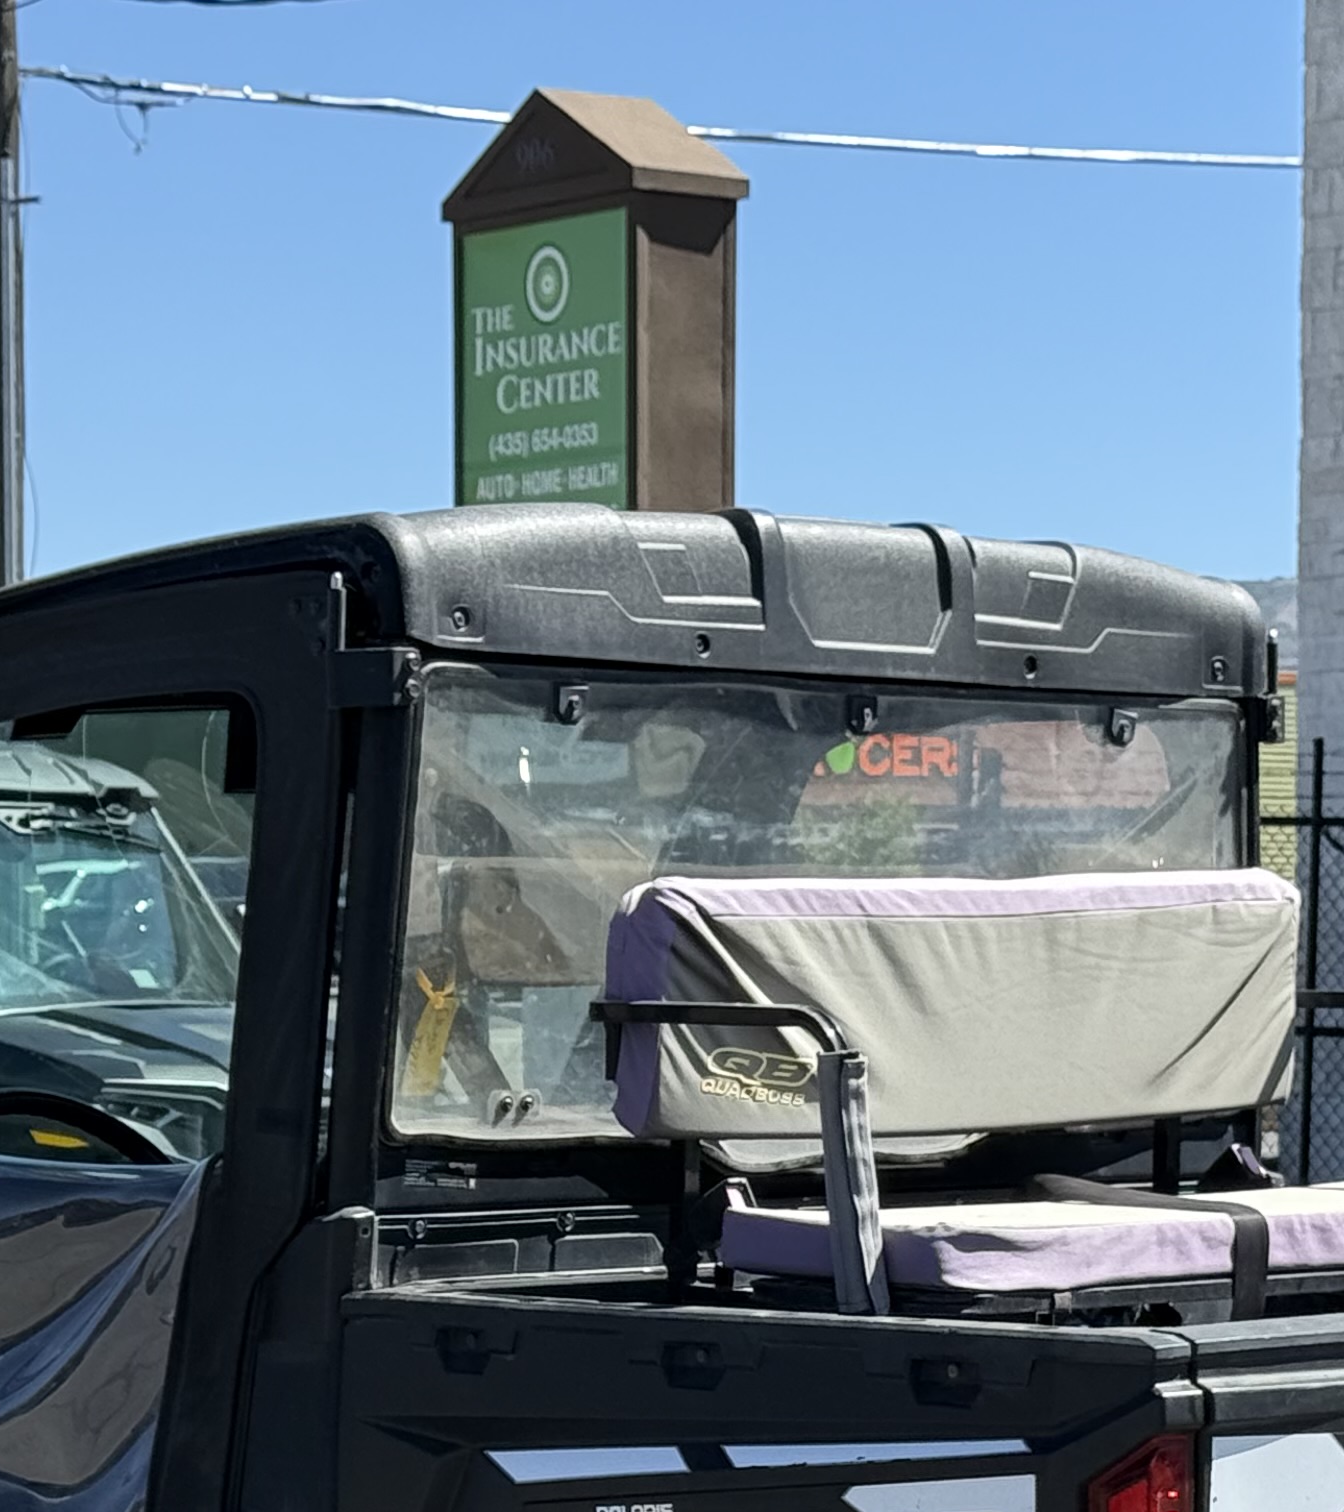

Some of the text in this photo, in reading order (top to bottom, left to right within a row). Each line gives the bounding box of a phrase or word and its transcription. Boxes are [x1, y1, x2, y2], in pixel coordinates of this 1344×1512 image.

[471, 304, 515, 336] THE
[473, 321, 623, 377] INSURANCE
[496, 368, 600, 414] CENTER
[476, 462, 620, 502] AUTO HOME HEALTH
